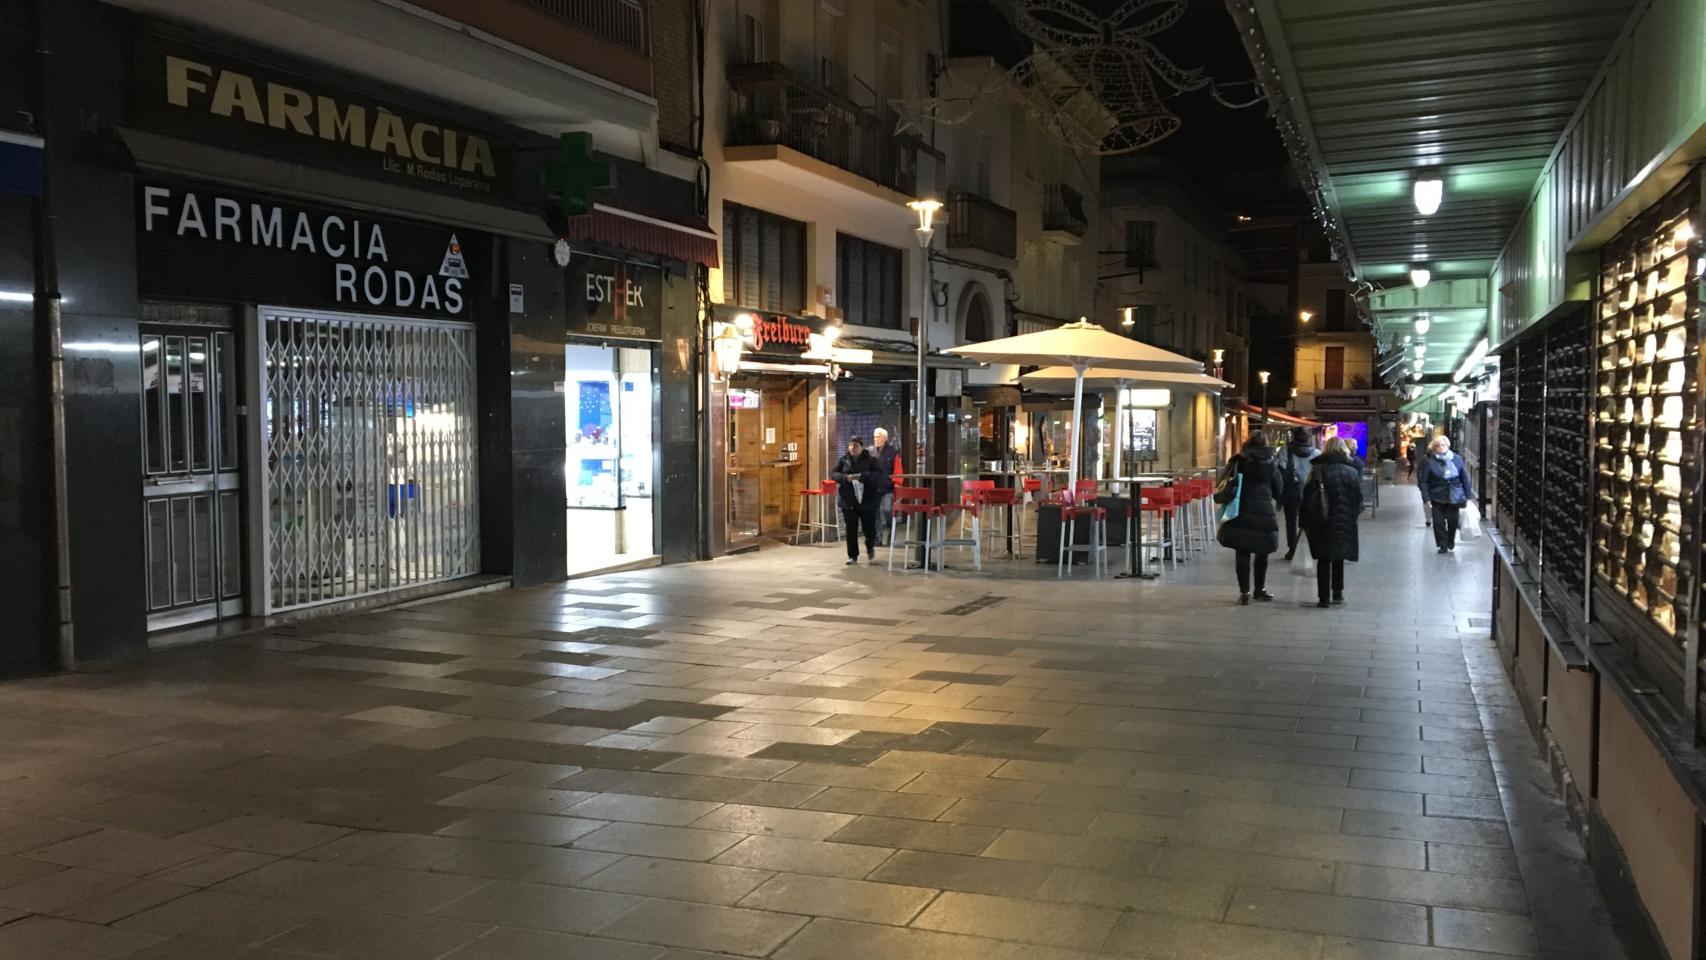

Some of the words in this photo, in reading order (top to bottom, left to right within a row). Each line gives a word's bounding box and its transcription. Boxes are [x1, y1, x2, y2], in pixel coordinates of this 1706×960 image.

[165, 54, 497, 177] FARMÀCIA
[143, 184, 389, 262] FARMACIA
[335, 261, 465, 315] RODAS
[751, 312, 812, 351] Freiburg
